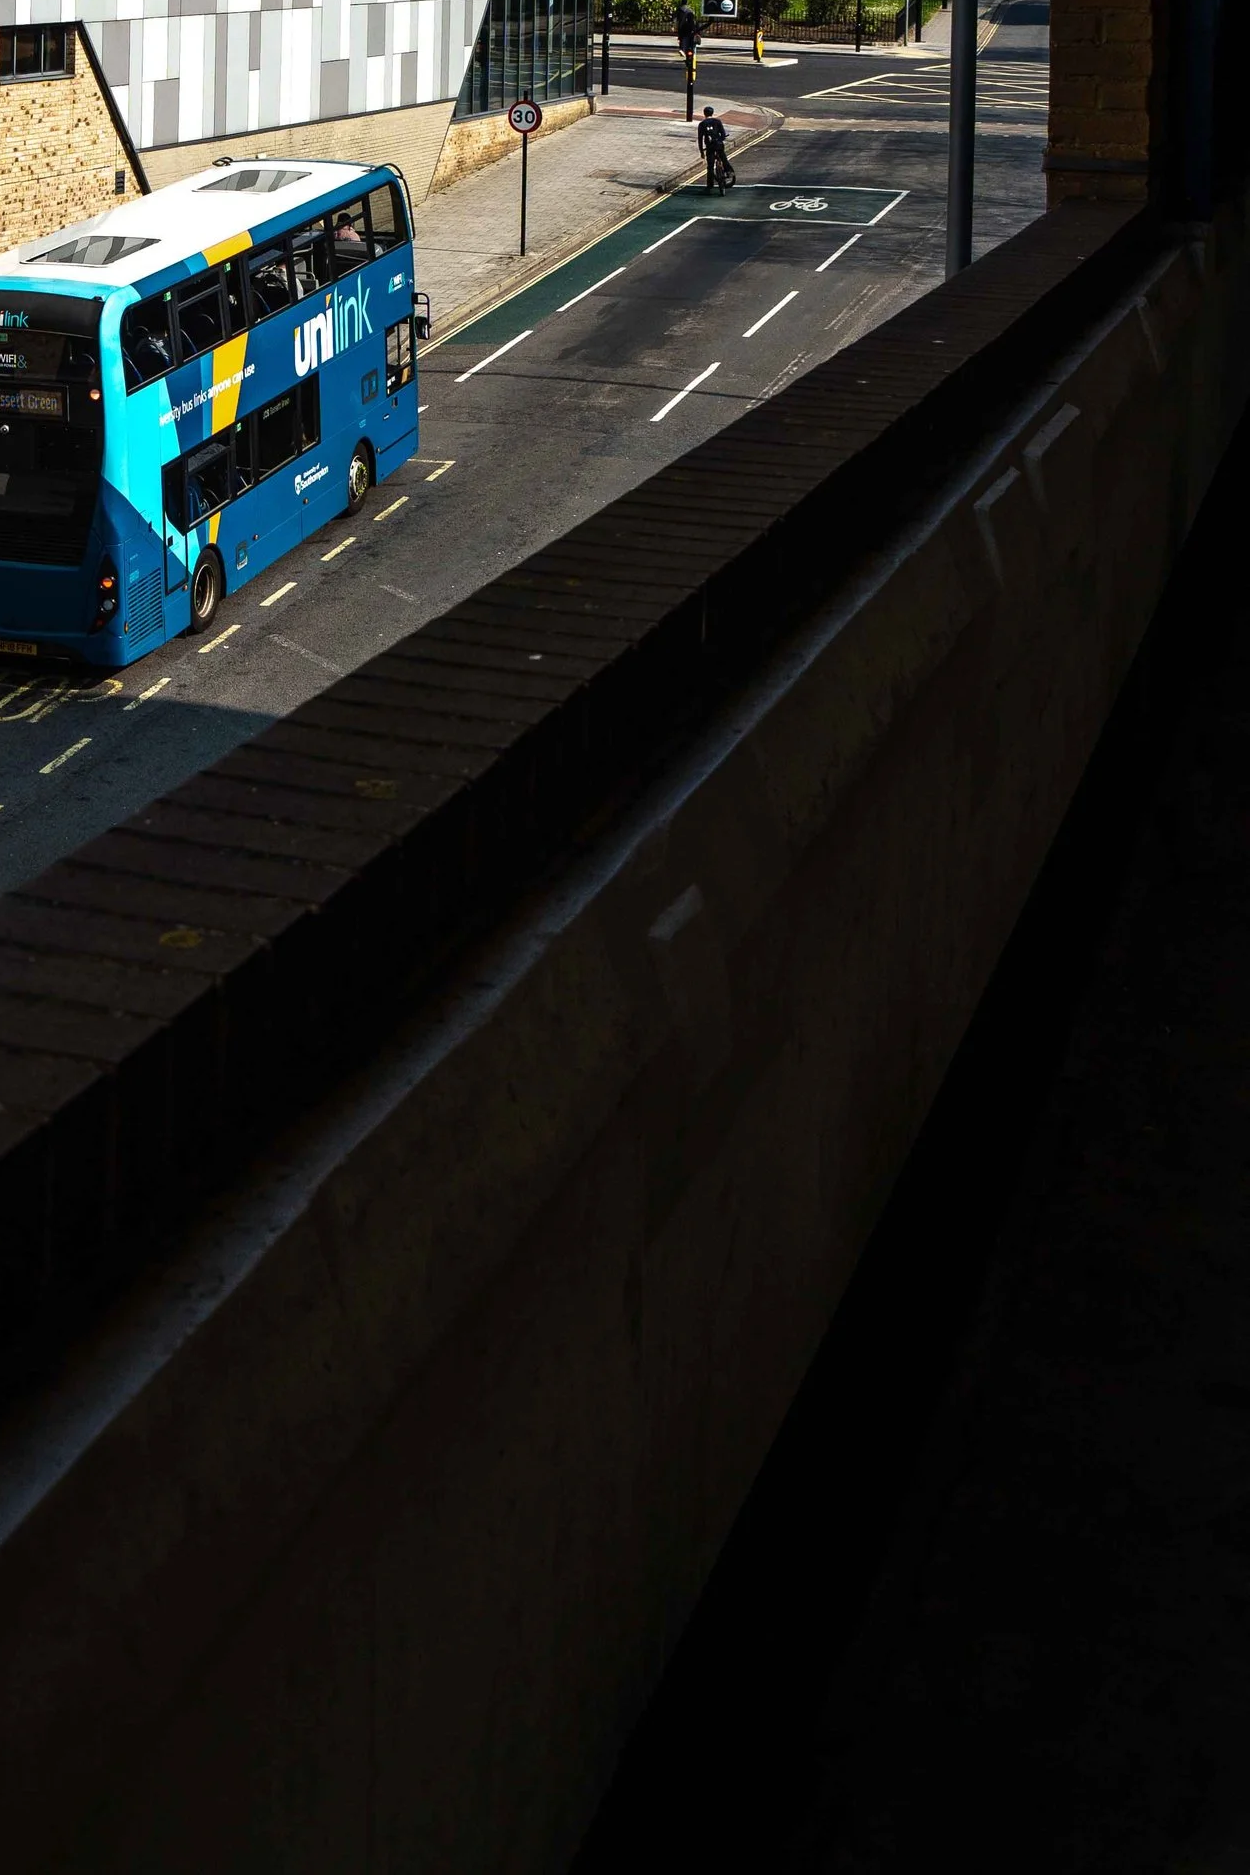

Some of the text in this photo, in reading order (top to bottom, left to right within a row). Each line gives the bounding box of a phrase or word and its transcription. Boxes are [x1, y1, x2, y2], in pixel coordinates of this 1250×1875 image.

[513, 110, 535, 123] 30
[294, 273, 373, 377] unilink
[27, 394, 57, 410] Green
[181, 400, 193, 414] bus
[193, 390, 207, 408] links
[207, 377, 231, 400] anyone
[232, 369, 244, 384] can
[244, 363, 255, 377] use
